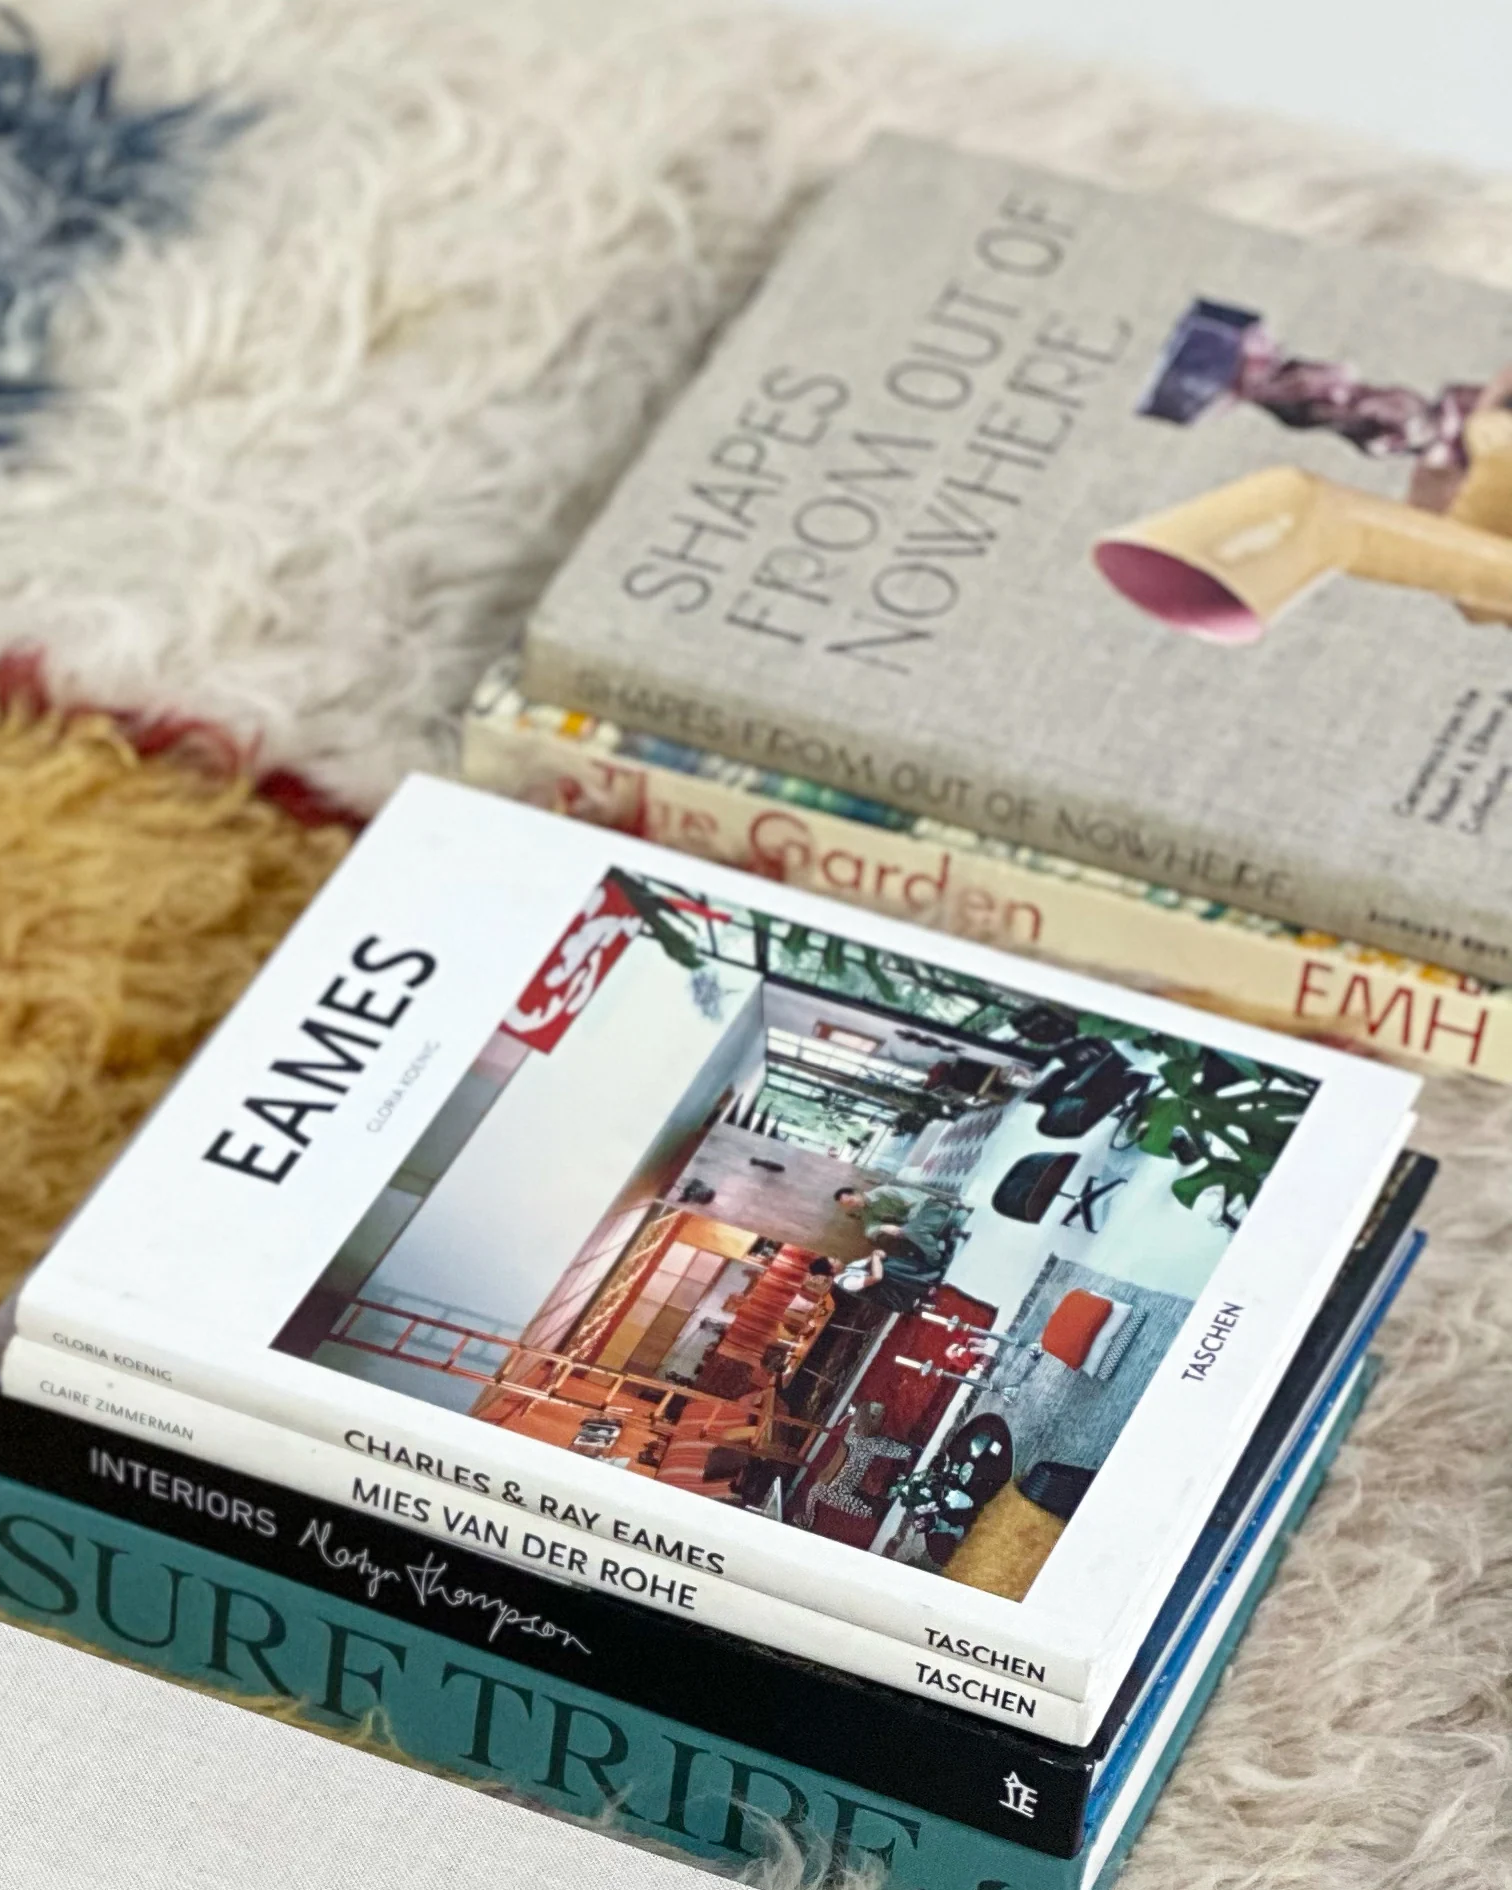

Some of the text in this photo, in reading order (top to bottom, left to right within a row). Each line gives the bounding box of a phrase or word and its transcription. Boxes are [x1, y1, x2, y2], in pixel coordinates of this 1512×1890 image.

[622, 364, 852, 616] SHAPES
[724, 192, 1076, 646] FROM OUT OF
[823, 315, 1134, 676] NOWHERE
[739, 715, 878, 785] FROM
[889, 760, 974, 812] OUT
[987, 789, 1037, 829] OF
[1055, 804, 1295, 902] NOWHERE
[202, 935, 438, 1185] EAMES
[748, 808, 1043, 944] Garden
[1294, 958, 1491, 1067] EMH
[1181, 1301, 1246, 1382] TASCHEN
[39, 1379, 1038, 1720] CLAIRE ZIMMERMAN MIES VAN DER ROHE TASCHEN
[52, 1331, 1046, 1684] GLORIA KOENIG CHARLES & RAY EAMES TASCHEN
[89, 1445, 279, 1538] INTERIORS
